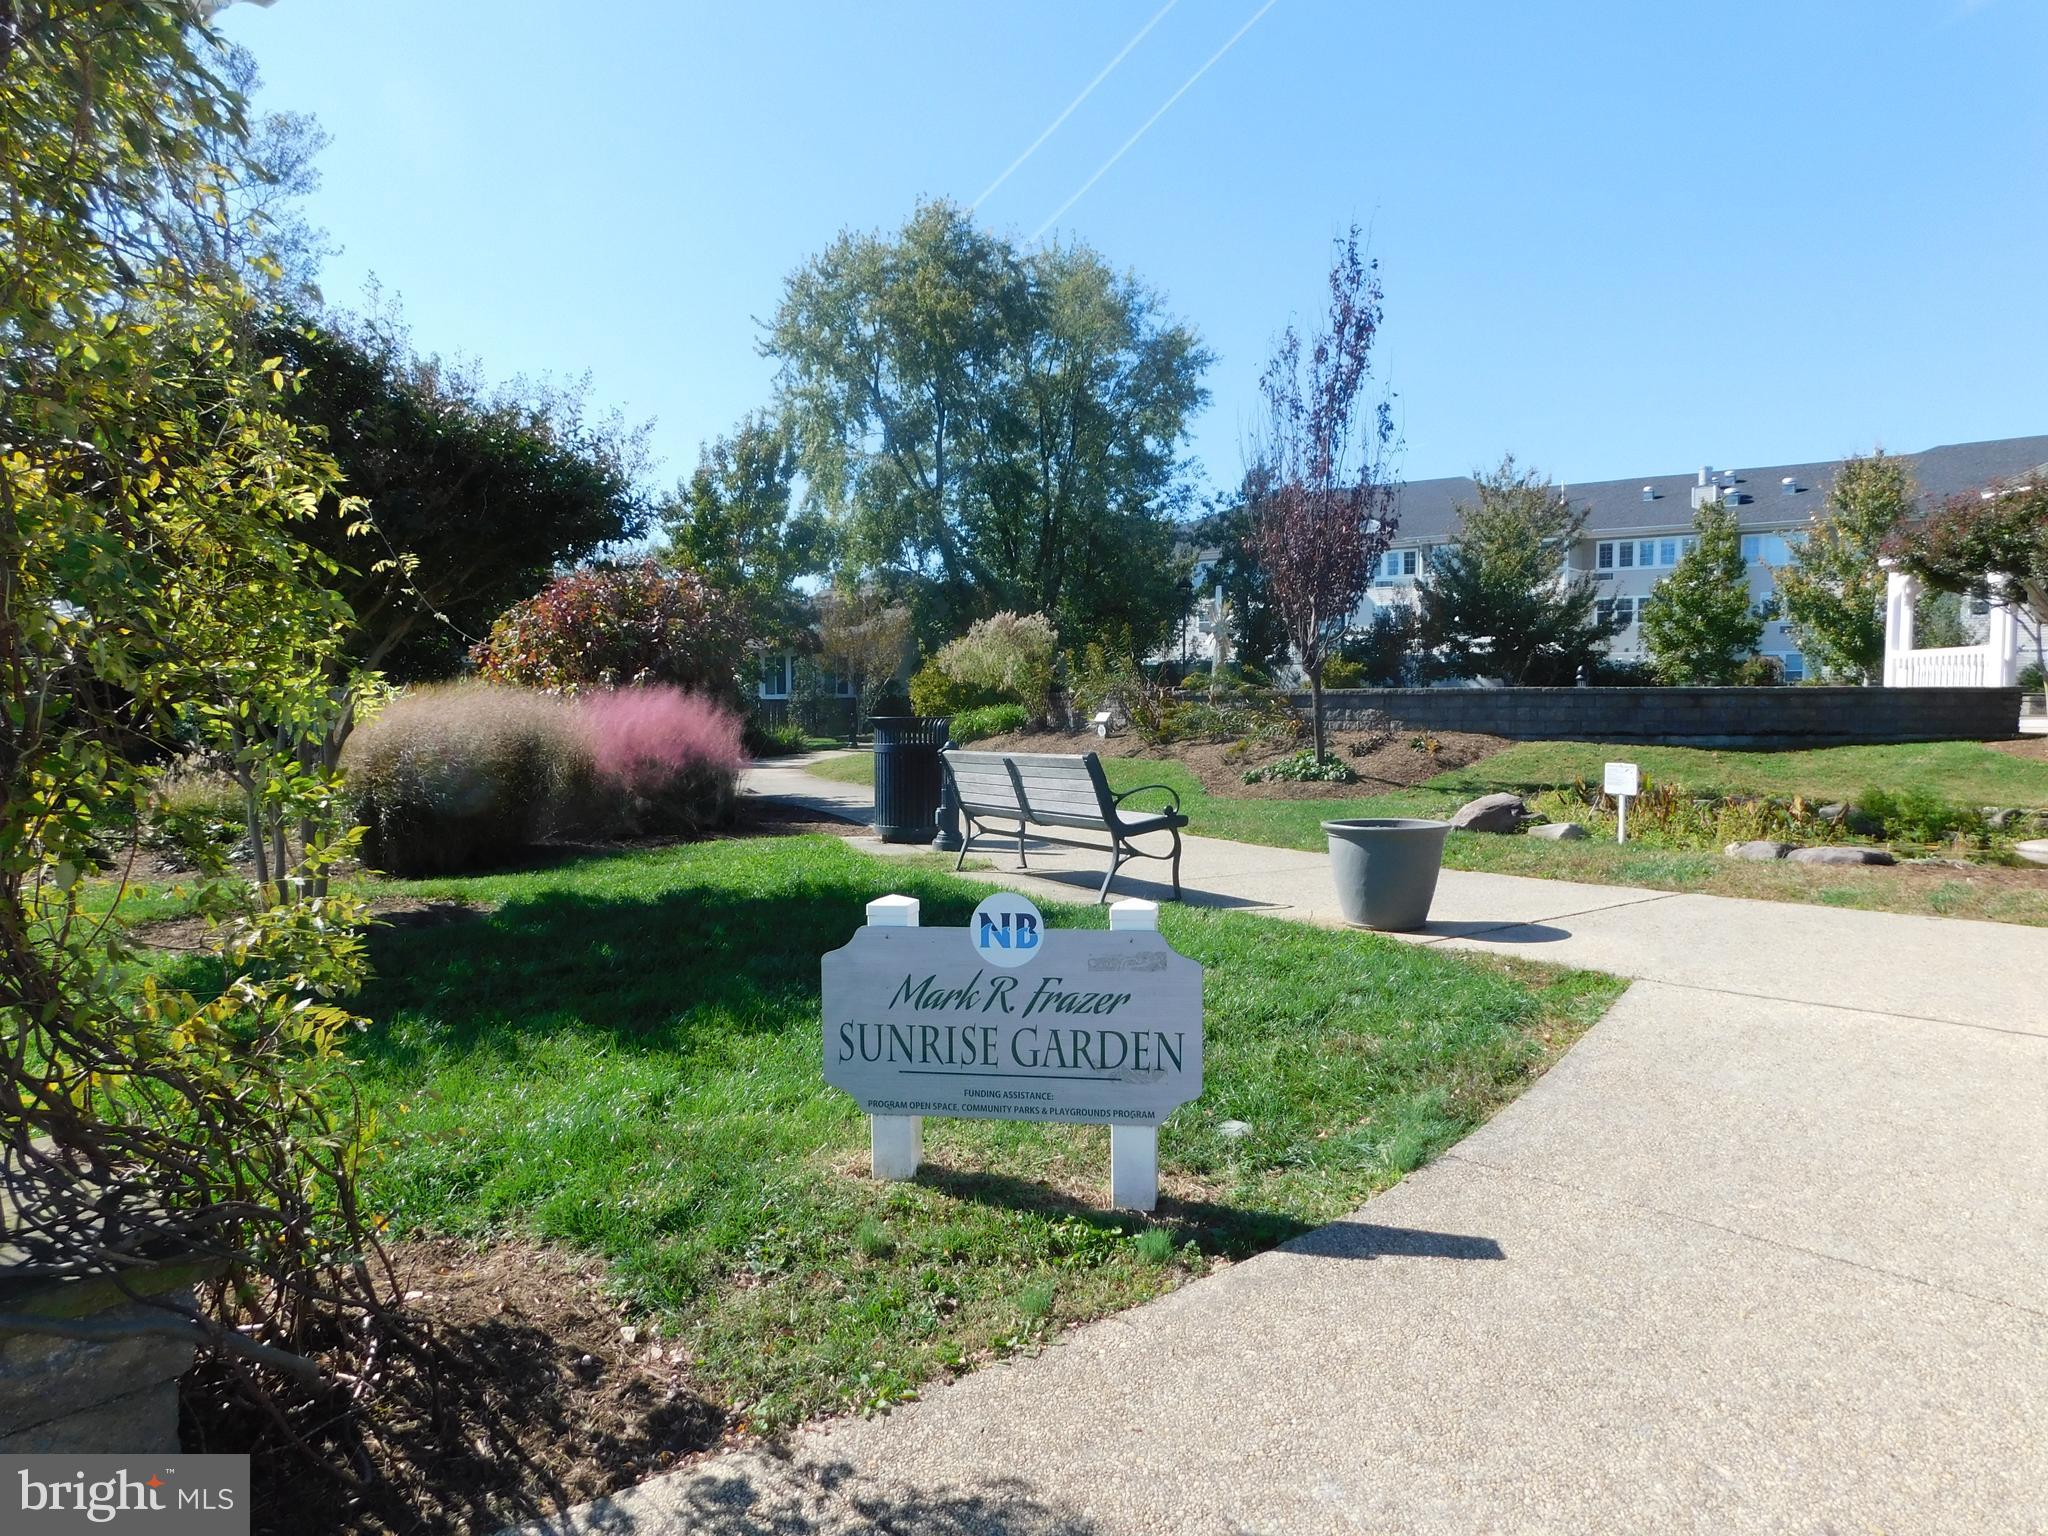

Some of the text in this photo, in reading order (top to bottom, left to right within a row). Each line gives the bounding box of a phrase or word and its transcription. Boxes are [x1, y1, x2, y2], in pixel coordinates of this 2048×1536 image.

[978, 911, 1039, 949] NB
[888, 968, 1131, 1018] Mark R. Frazer
[838, 1019, 1184, 1074] SUNRISE GARDEN
[867, 1099, 1156, 1119] PROGRAM OPEN SPACE, COMMUNITY PARKS & PLAYGROUNDS PROGRAM
[963, 1089, 1054, 1101] FUNDING ASSISTANCE:
